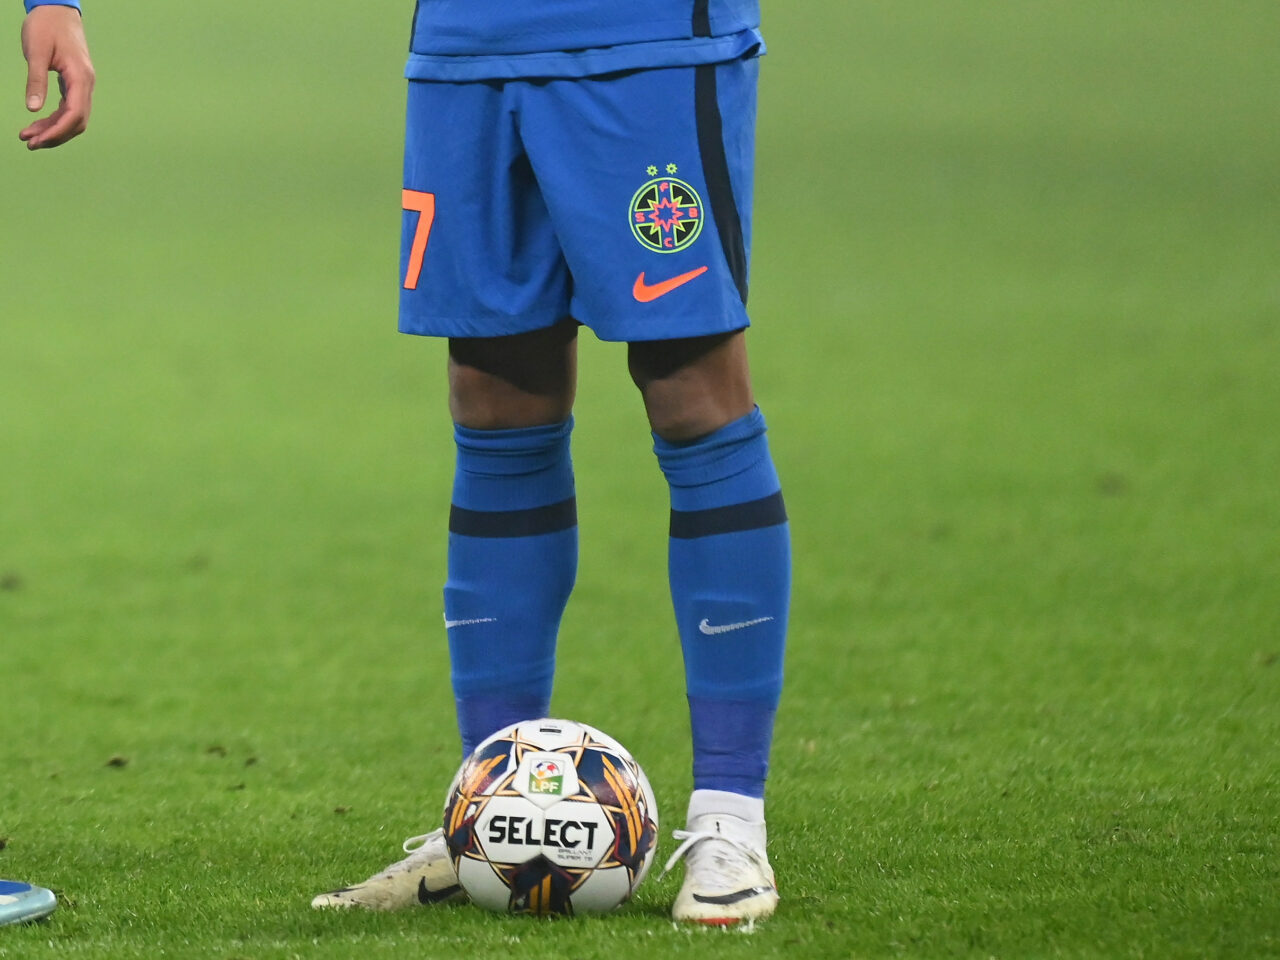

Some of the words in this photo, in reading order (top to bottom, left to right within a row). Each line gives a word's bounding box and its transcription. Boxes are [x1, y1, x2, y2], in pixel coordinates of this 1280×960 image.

[401, 188, 436, 291] 7
[531, 780, 560, 794] LPF
[488, 815, 599, 850] SELECT
